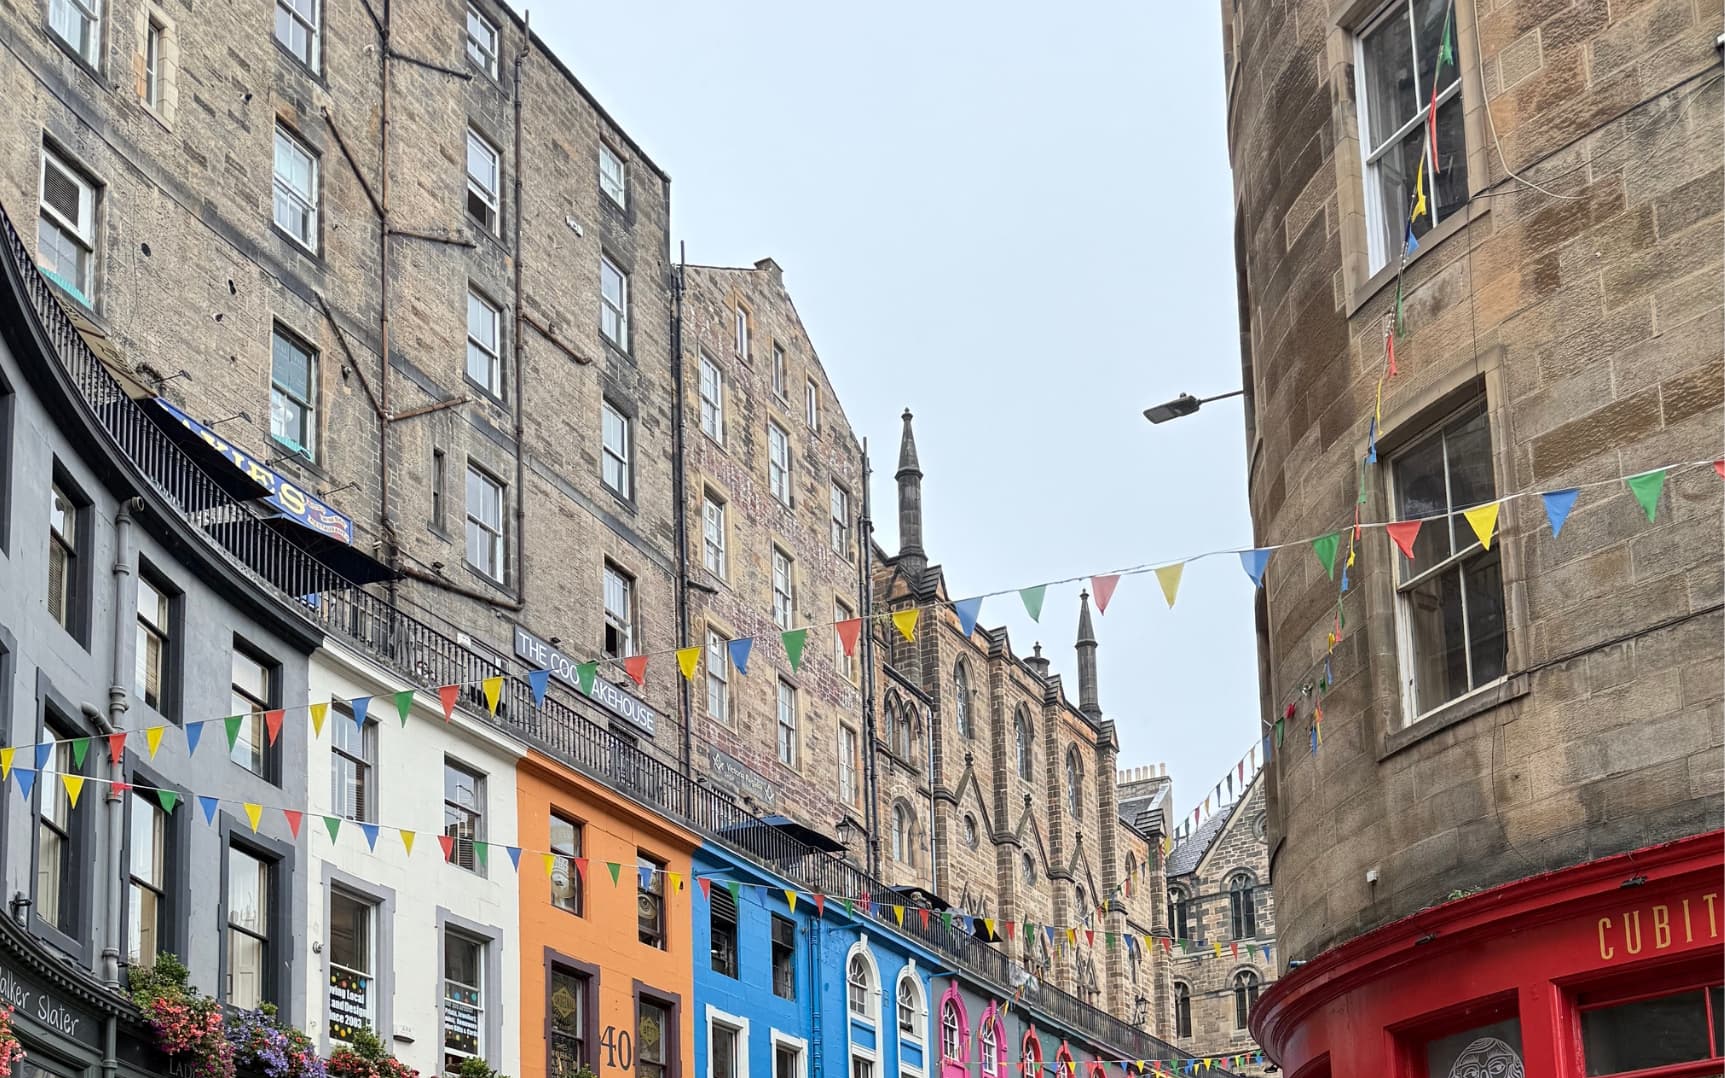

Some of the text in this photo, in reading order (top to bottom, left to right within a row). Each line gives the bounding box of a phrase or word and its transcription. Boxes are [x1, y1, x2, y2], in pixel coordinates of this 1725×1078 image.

[519, 632, 548, 666] THE
[590, 676, 654, 731] AKEHOUSE
[1598, 893, 1718, 961] CUBIT
[0, 968, 79, 1036] alker Slater
[600, 1025, 632, 1071] 40
